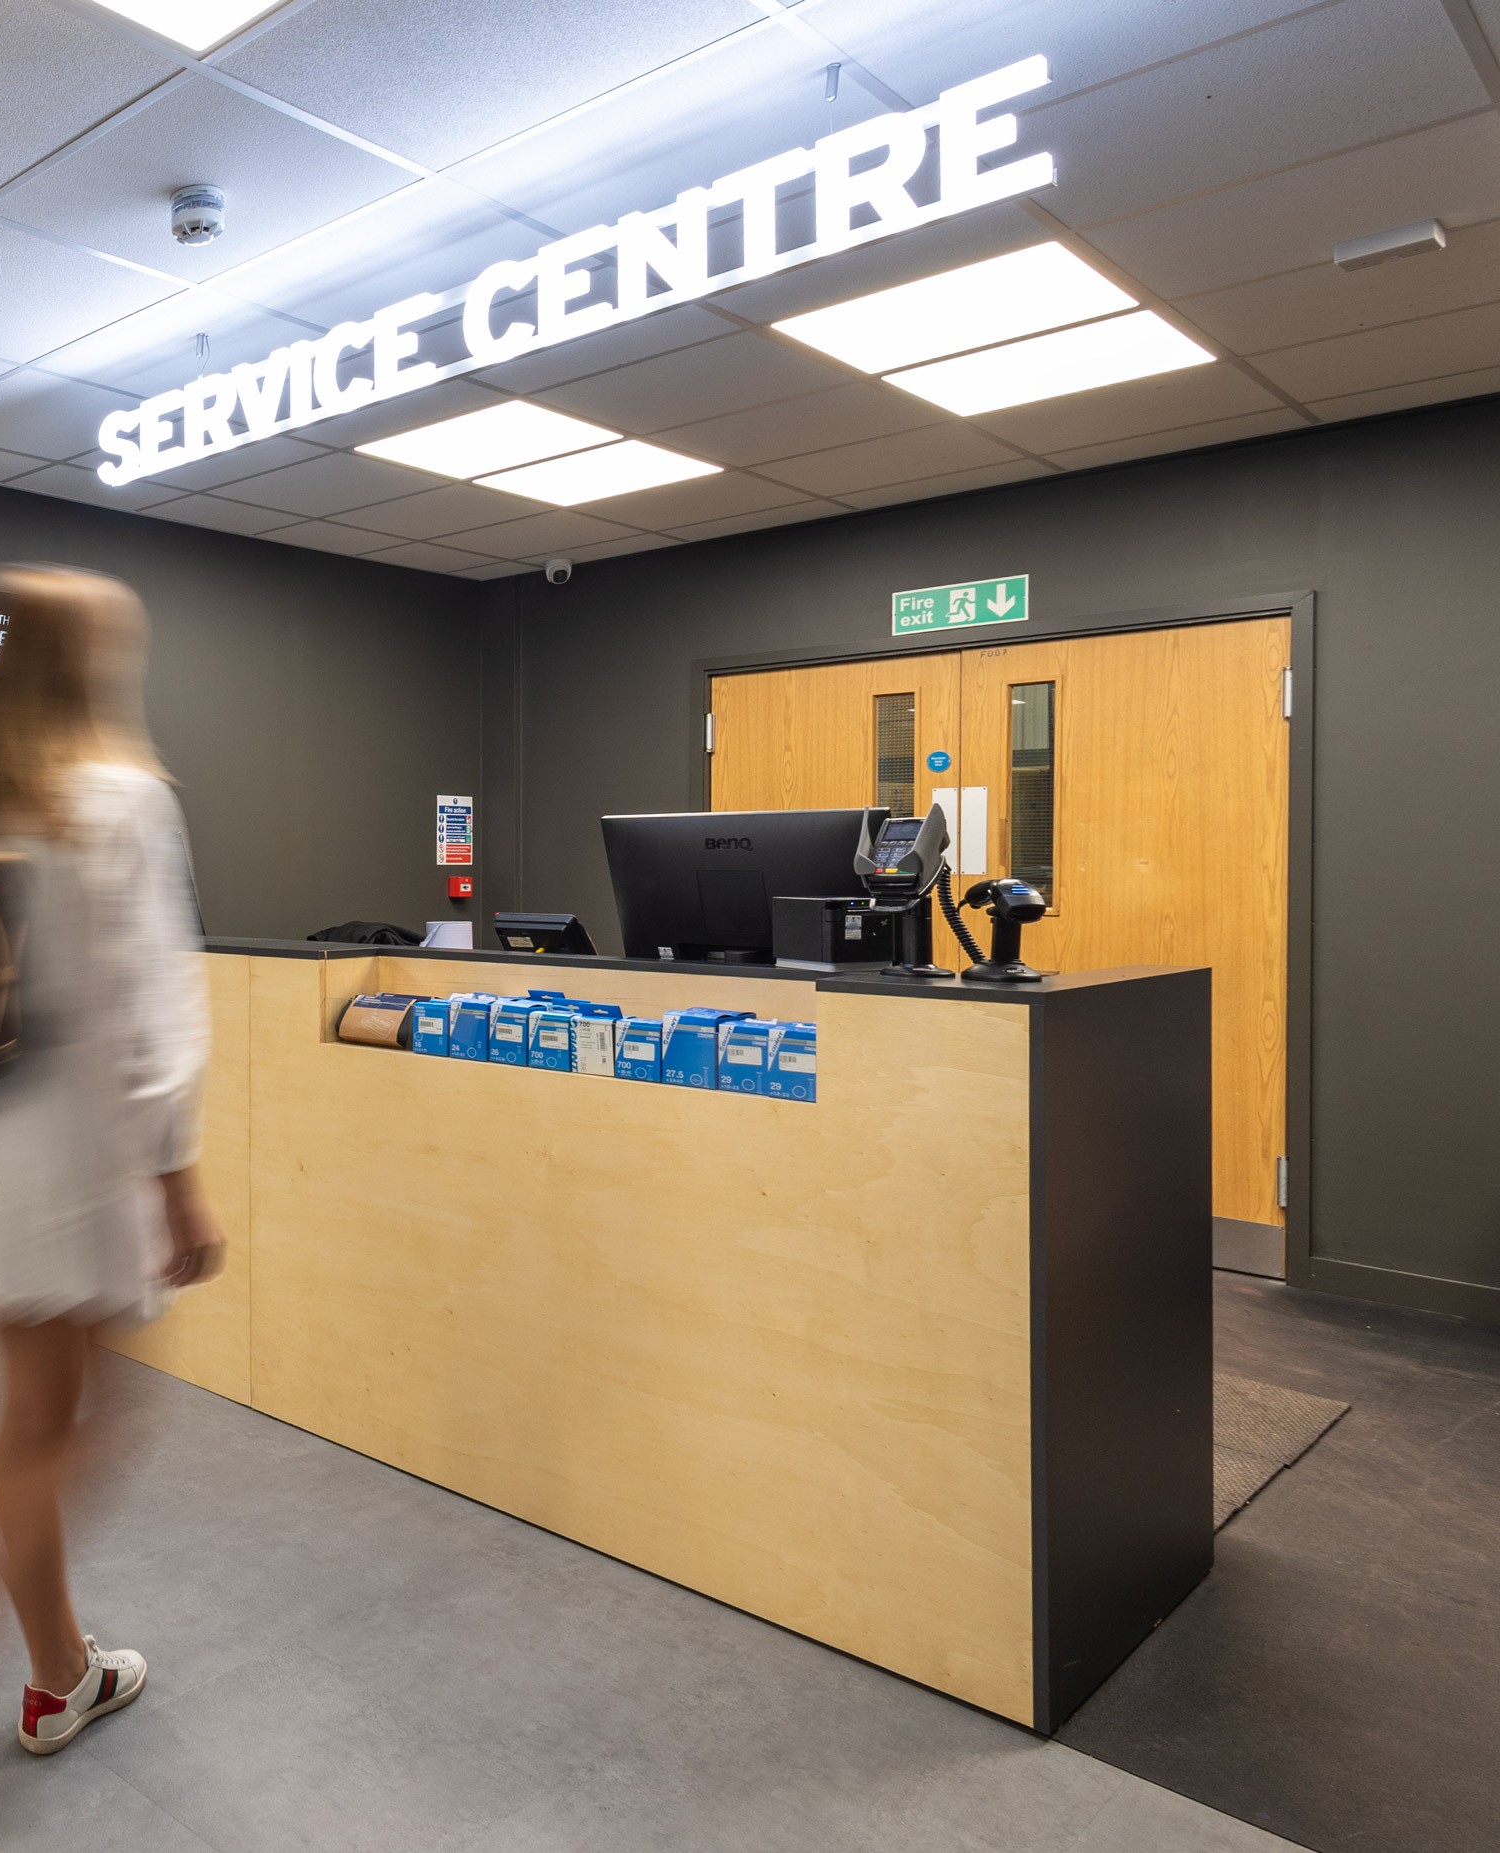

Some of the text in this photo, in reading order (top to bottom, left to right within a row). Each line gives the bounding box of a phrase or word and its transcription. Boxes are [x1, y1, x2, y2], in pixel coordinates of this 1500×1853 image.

[97, 53, 1057, 486] SERVICE CENTRE
[900, 597, 934, 612] Fire
[900, 610, 934, 627] exit
[704, 837, 753, 851] BenQ
[579, 1020, 591, 1028] 700
[530, 1050, 544, 1058] 700
[617, 1060, 632, 1069] 700
[665, 1069, 684, 1078] 27.5
[720, 1075, 732, 1084] 29
[769, 1081, 782, 1090] 29
